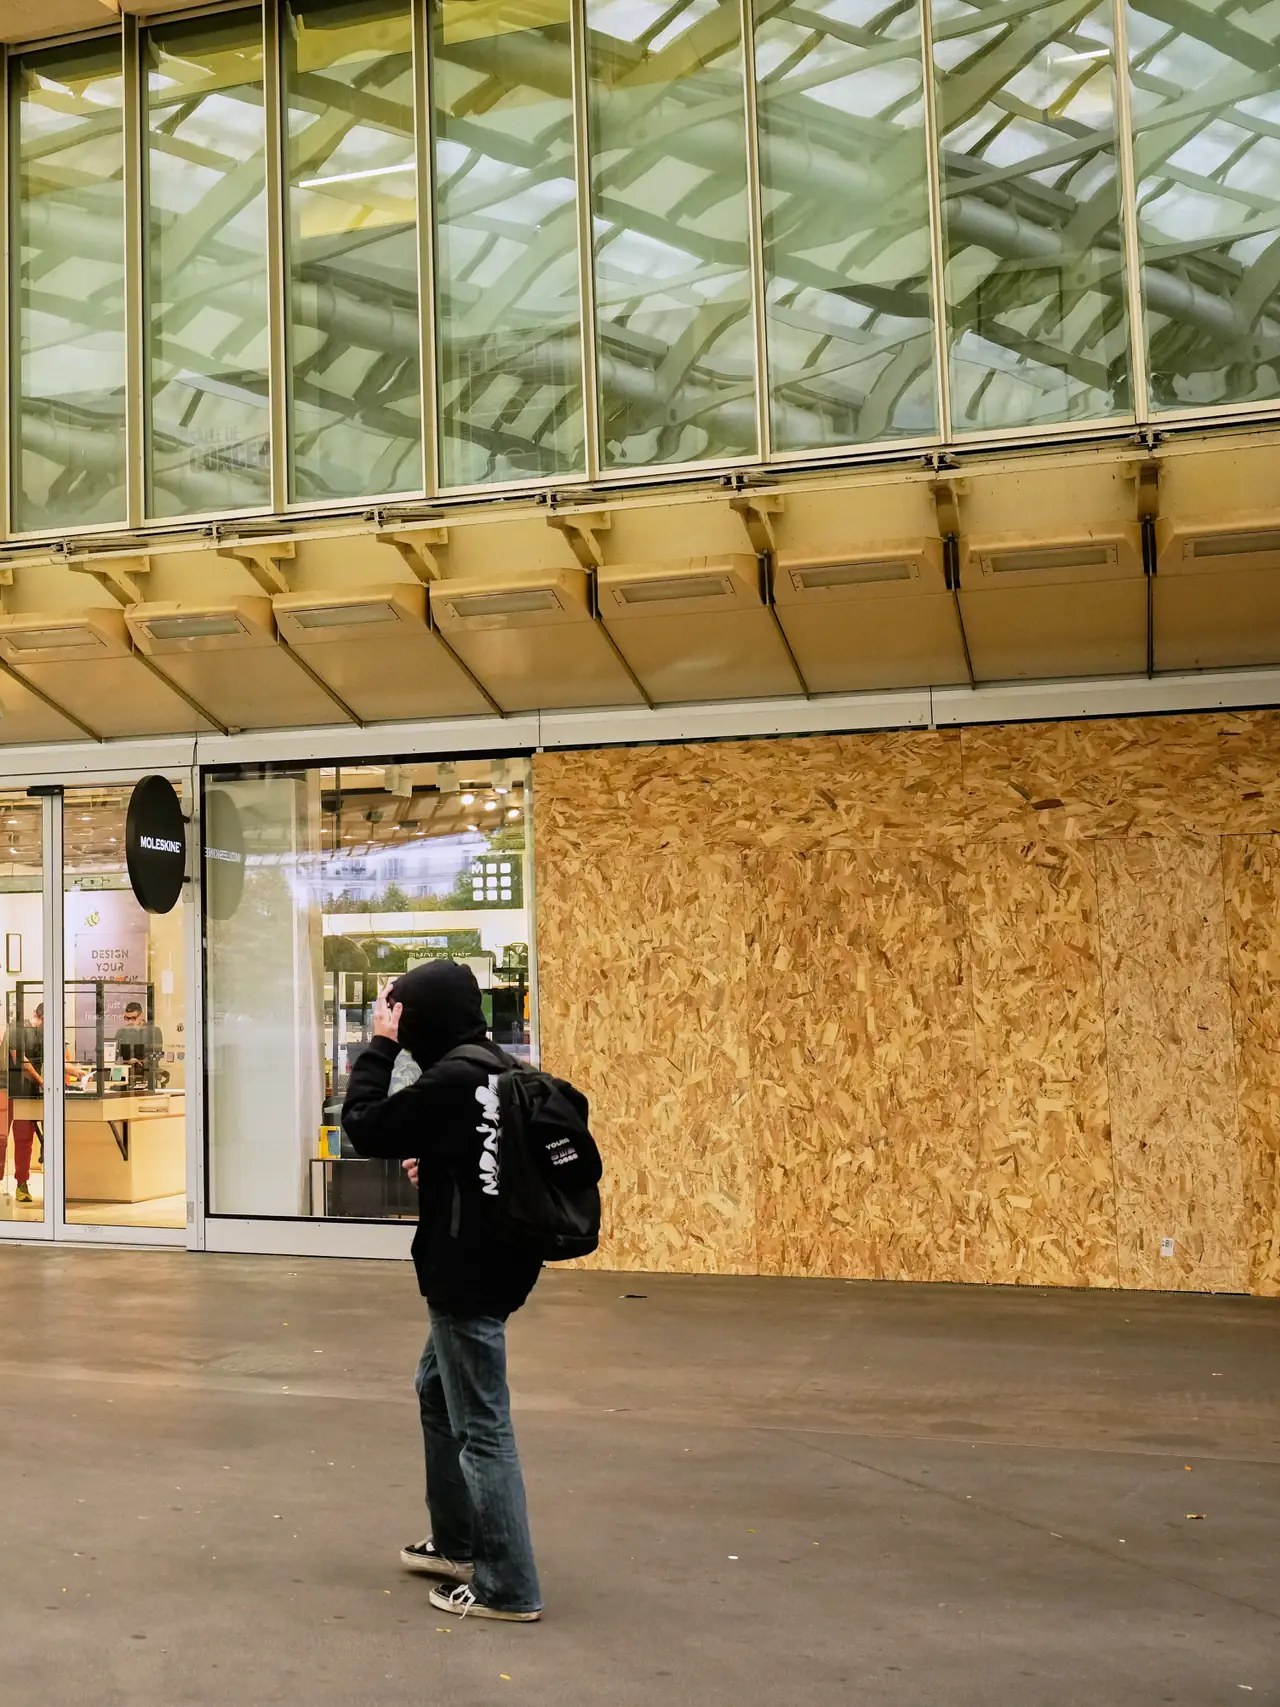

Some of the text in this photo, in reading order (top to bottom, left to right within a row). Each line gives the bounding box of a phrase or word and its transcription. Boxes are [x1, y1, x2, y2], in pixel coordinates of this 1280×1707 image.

[140, 836, 181, 853] MOLESKINE
[91, 949, 129, 959] DESIGN
[96, 962, 125, 972] YOUR
